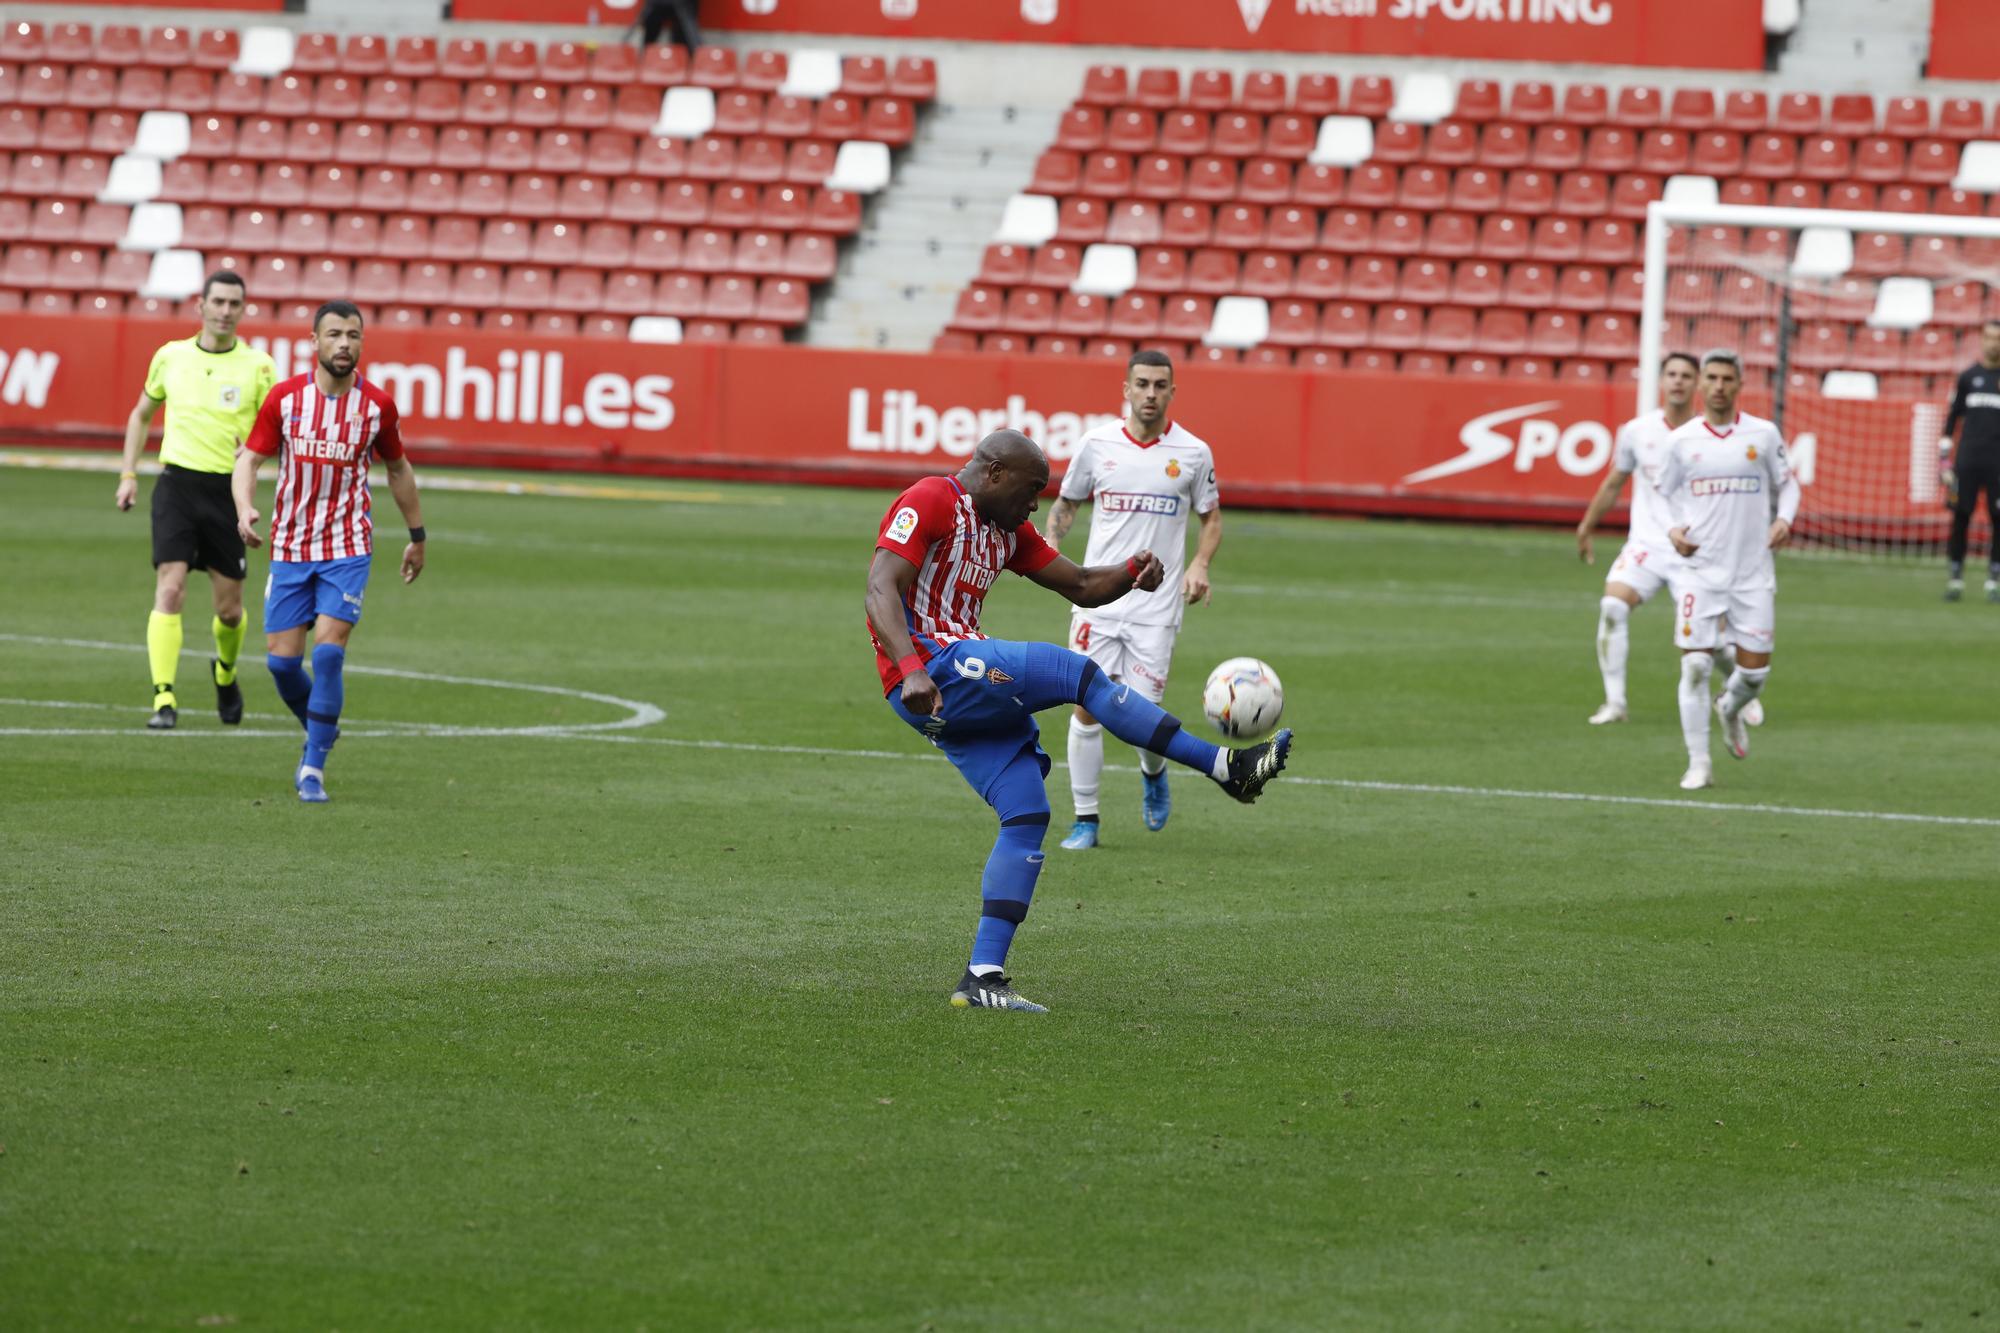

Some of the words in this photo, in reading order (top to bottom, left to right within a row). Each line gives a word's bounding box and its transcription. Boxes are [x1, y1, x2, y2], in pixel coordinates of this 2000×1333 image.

[1102, 493, 1178, 514] BETFRED
[1682, 592, 1695, 618] 8
[954, 656, 985, 680] 6
